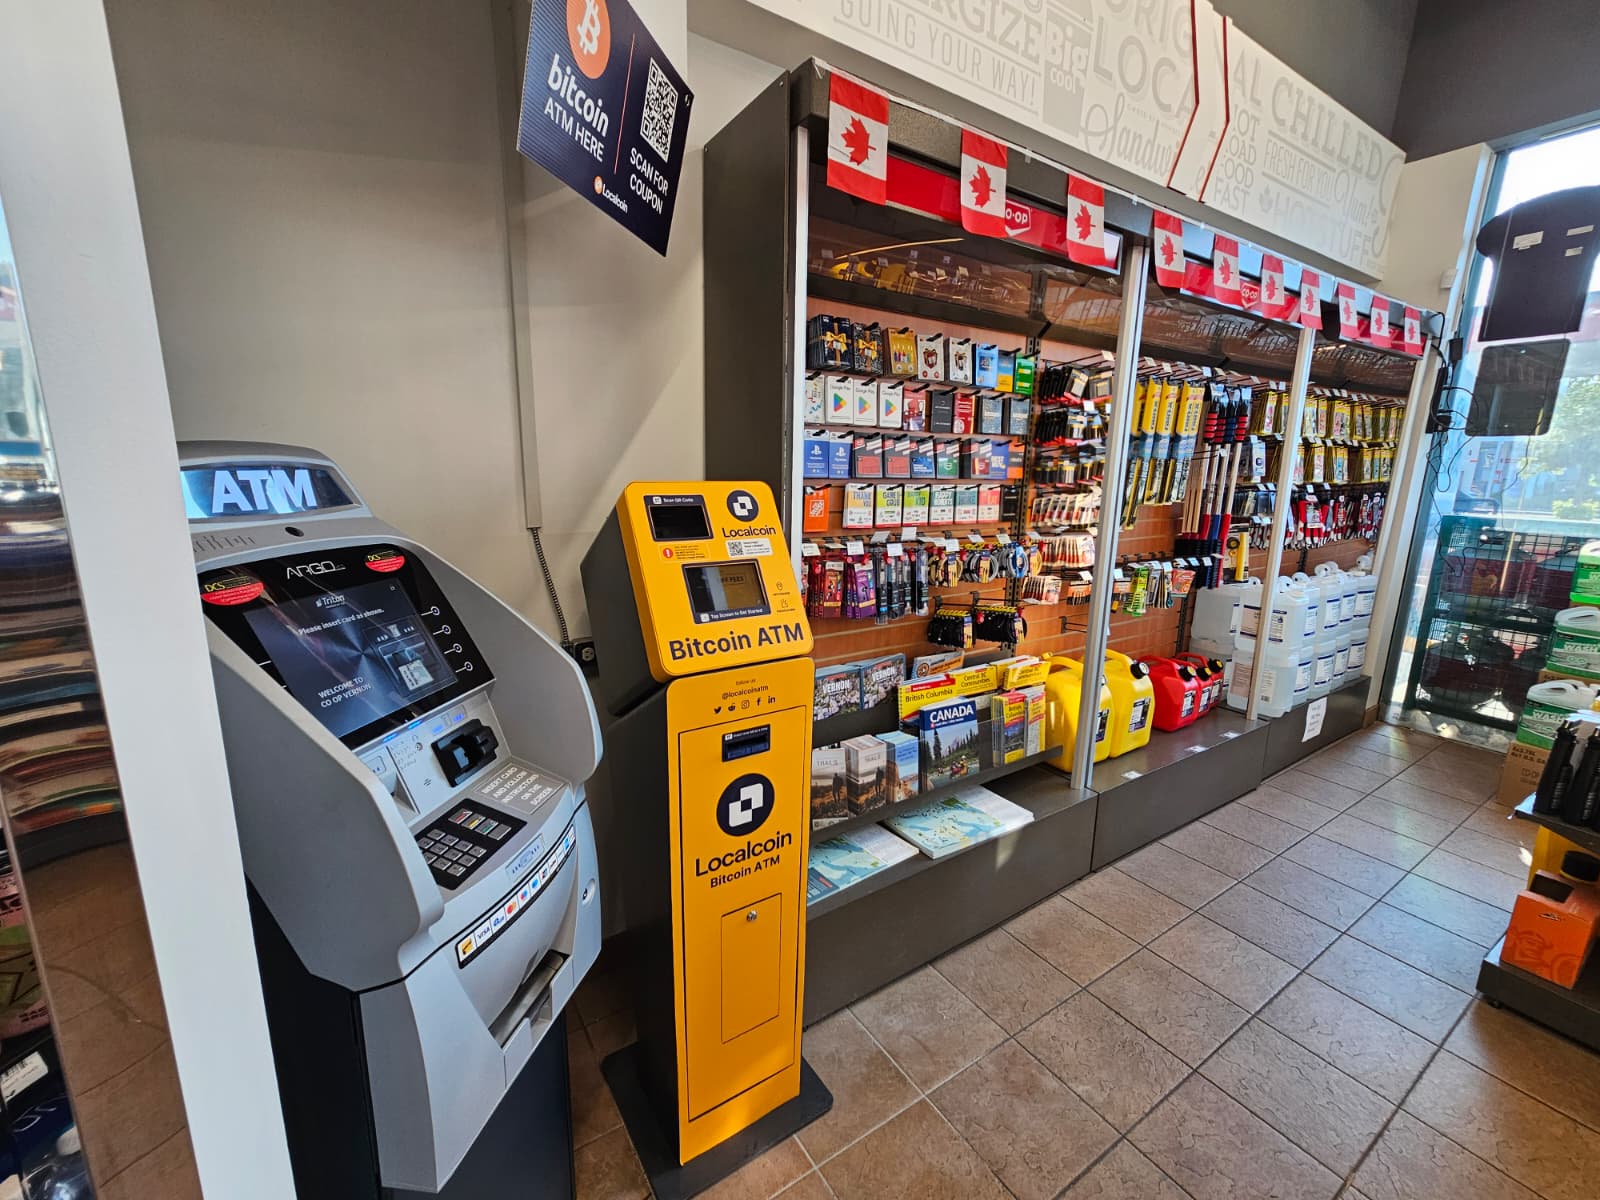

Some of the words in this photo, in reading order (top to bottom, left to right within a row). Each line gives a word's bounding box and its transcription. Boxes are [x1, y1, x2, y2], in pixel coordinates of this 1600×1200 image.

[1105, 0, 1192, 58] RIG
[928, 23, 982, 82] YOUR
[991, 56, 1036, 107] WAY!
[547, 53, 609, 137] bitcoin
[544, 97, 573, 136] ATM
[575, 122, 604, 162] HERE
[1271, 76, 1383, 181] CHILLED
[1226, 135, 1256, 167] OAD
[1264, 139, 1296, 182] FRESH
[630, 147, 653, 180] SCAN
[653, 169, 669, 196] FOR
[1221, 157, 1254, 189] OOD
[602, 183, 628, 213] Localcoin
[629, 173, 663, 214] COUPON
[1214, 177, 1249, 216] FAST
[211, 468, 318, 513] ATM
[722, 524, 777, 538] Localcoin
[286, 560, 336, 580] ARGO
[322, 594, 345, 606] Triton
[298, 624, 322, 636] Please
[322, 618, 341, 629] insert
[341, 614, 355, 622] card
[669, 630, 752, 661] Bitcoin
[757, 622, 804, 647] ATM
[318, 680, 354, 699] WELCOME
[353, 676, 364, 685] TO
[822, 679, 851, 694] VERNON
[871, 666, 897, 681] VERNON
[343, 683, 372, 699] VERNON
[722, 685, 769, 700] @localcoinatm
[905, 691, 925, 703] British
[925, 688, 953, 699] Columbia
[929, 704, 974, 723] CANADA
[695, 831, 792, 877] Localcoin
[710, 866, 751, 889] Bitcoin
[754, 855, 781, 873] ATM
[476, 927, 491, 940] VISA
